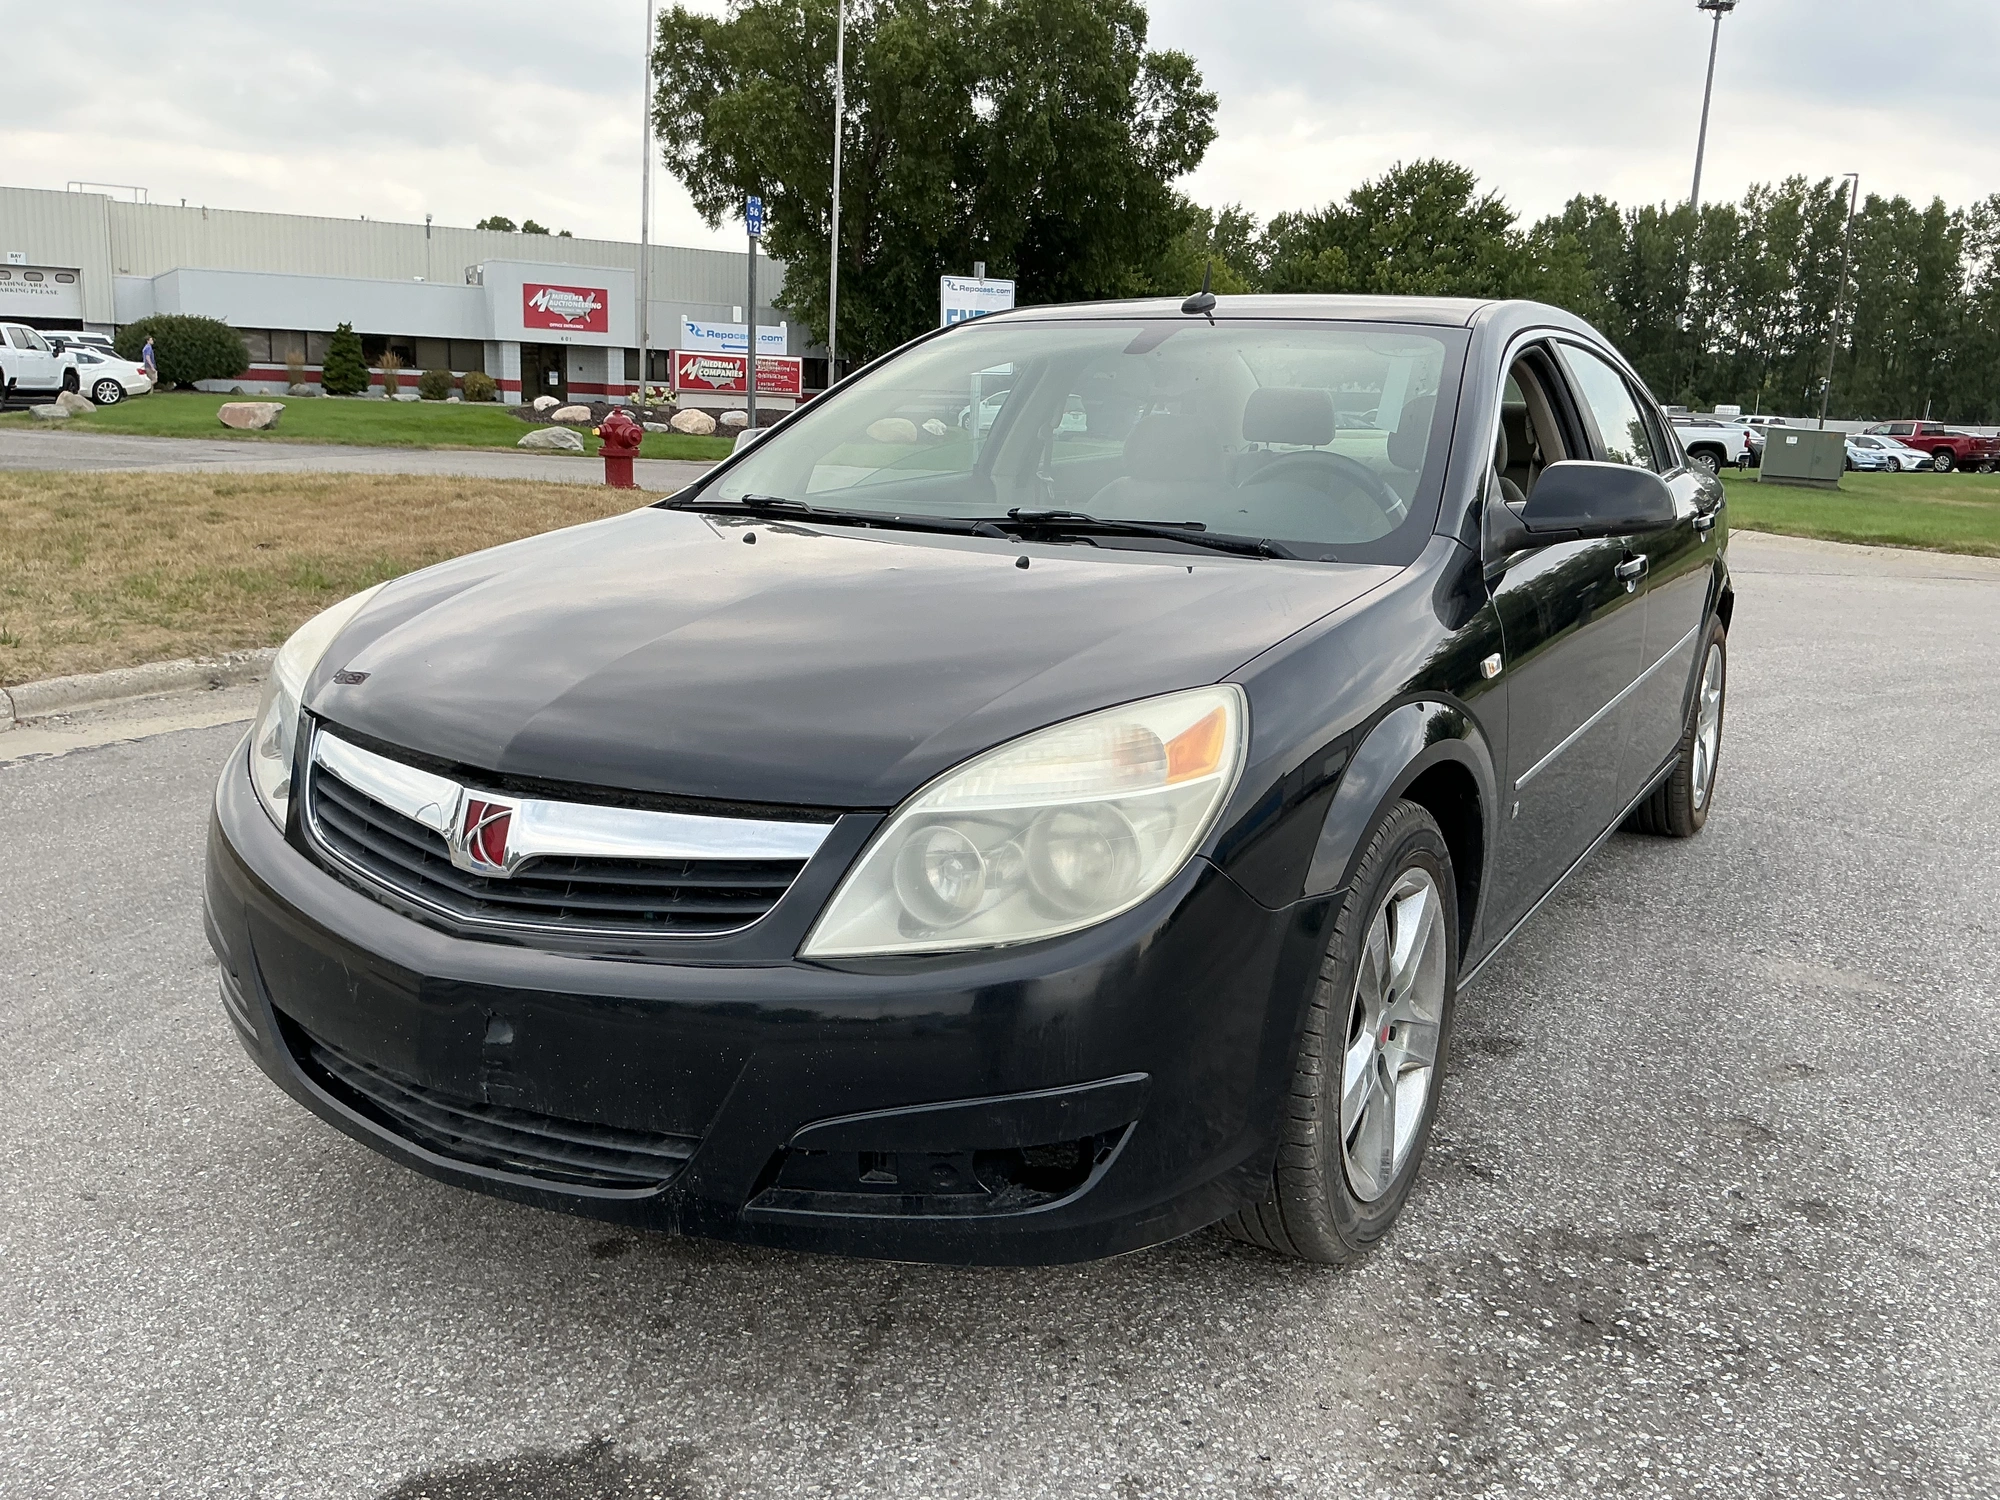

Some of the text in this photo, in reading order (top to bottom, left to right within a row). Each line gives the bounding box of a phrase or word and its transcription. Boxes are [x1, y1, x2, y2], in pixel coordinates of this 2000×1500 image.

[749, 207, 759, 217] 56
[749, 220, 759, 232] 12
[959, 285, 1011, 294] Repocast.com
[551, 293, 584, 302] MIEDEMA
[549, 300, 602, 309] AUCTIONEERING
[706, 330, 783, 342] Repoca.com
[700, 360, 734, 369] MIEDEMA
[699, 368, 743, 378] COMPANIES
